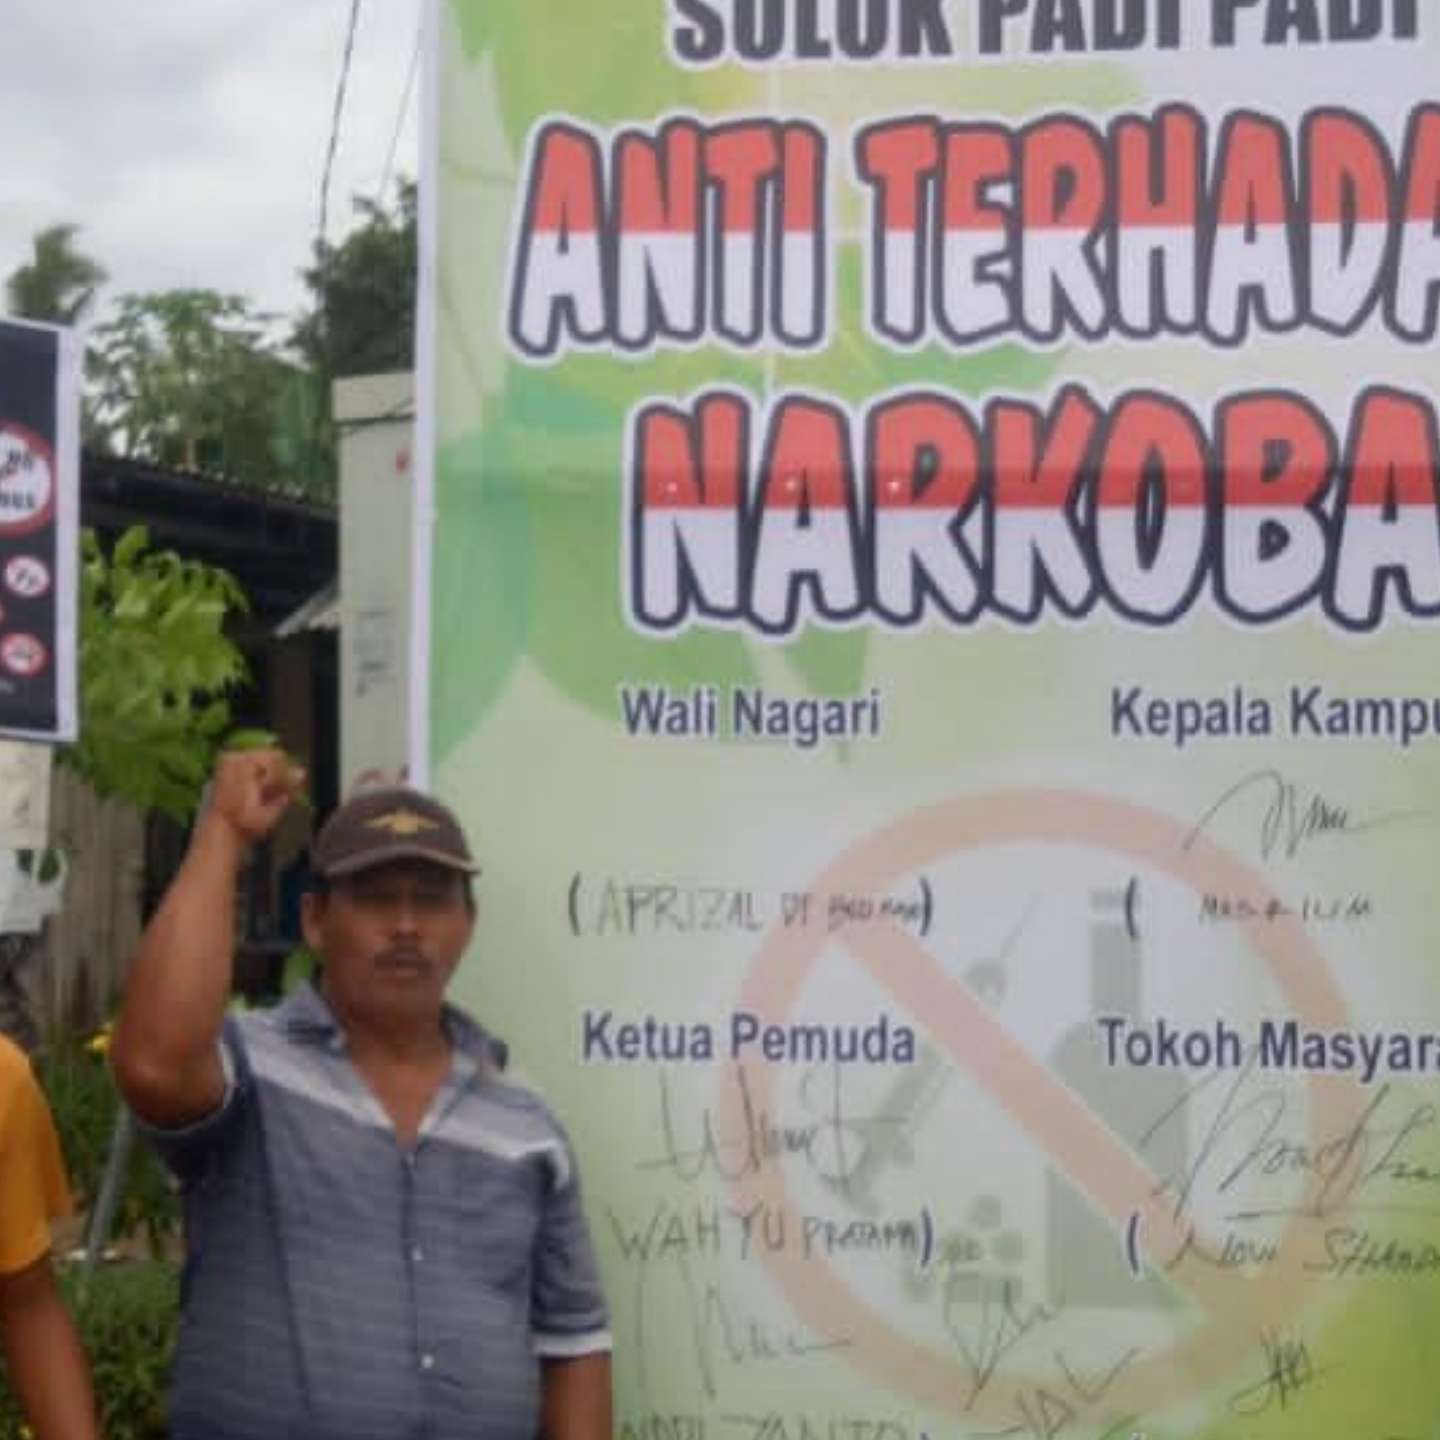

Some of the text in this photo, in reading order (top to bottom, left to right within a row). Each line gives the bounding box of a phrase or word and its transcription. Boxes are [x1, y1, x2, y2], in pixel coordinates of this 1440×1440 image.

[509, 118, 827, 358] ANTI
[621, 688, 881, 748] Wali Nagari
[1111, 686, 1272, 745] Kepala
[582, 1010, 916, 1064] Ketua Pemuda
[1099, 1018, 1242, 1069] Tokoh
